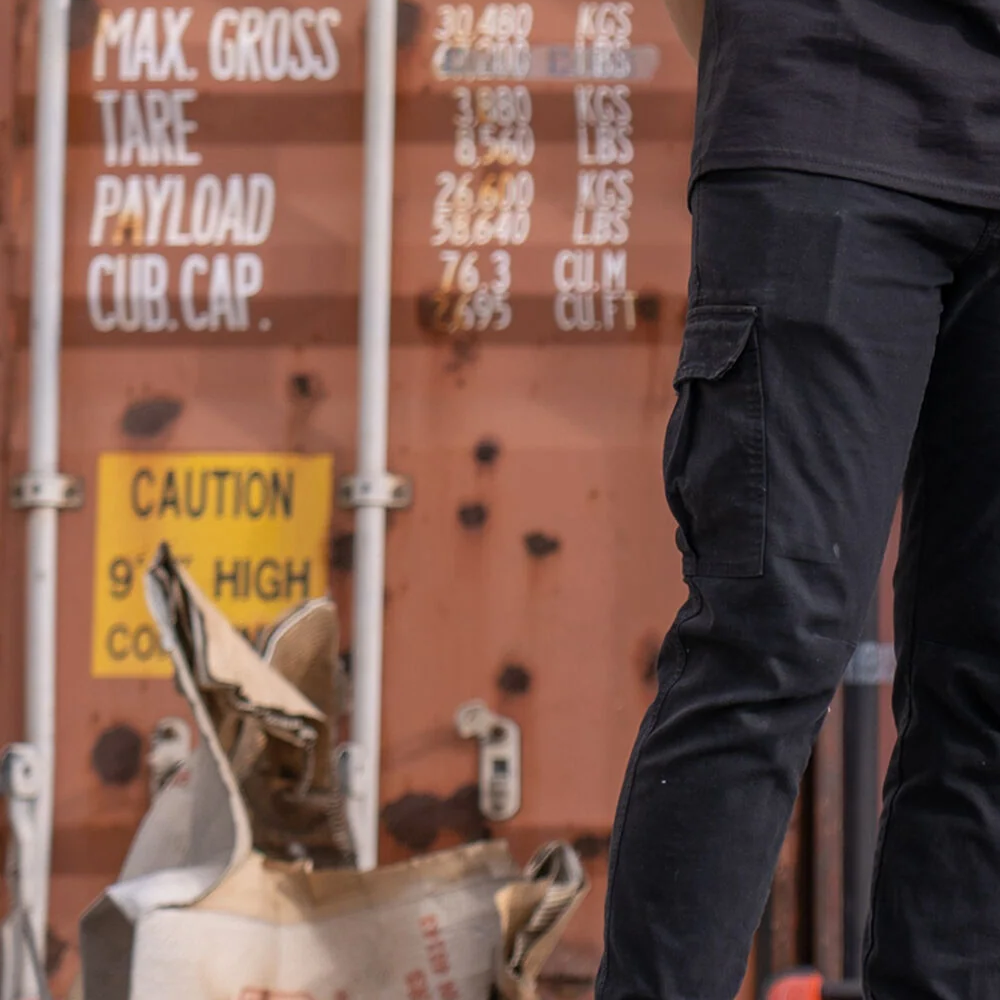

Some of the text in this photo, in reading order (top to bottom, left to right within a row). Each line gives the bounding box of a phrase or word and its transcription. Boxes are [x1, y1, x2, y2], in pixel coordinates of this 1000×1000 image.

[574, 1, 634, 41] KGS
[92, 6, 342, 82] MAX. GROSS
[573, 84, 633, 127] KGS
[92, 88, 202, 168] TARE
[577, 125, 635, 165] LBS
[88, 172, 276, 247] PAYLOAD
[577, 169, 634, 208] KGS
[572, 205, 631, 245] LBS
[438, 249, 511, 294] 76.3
[131, 467, 296, 519] CAUTION
[213, 557, 312, 601] HIGH
